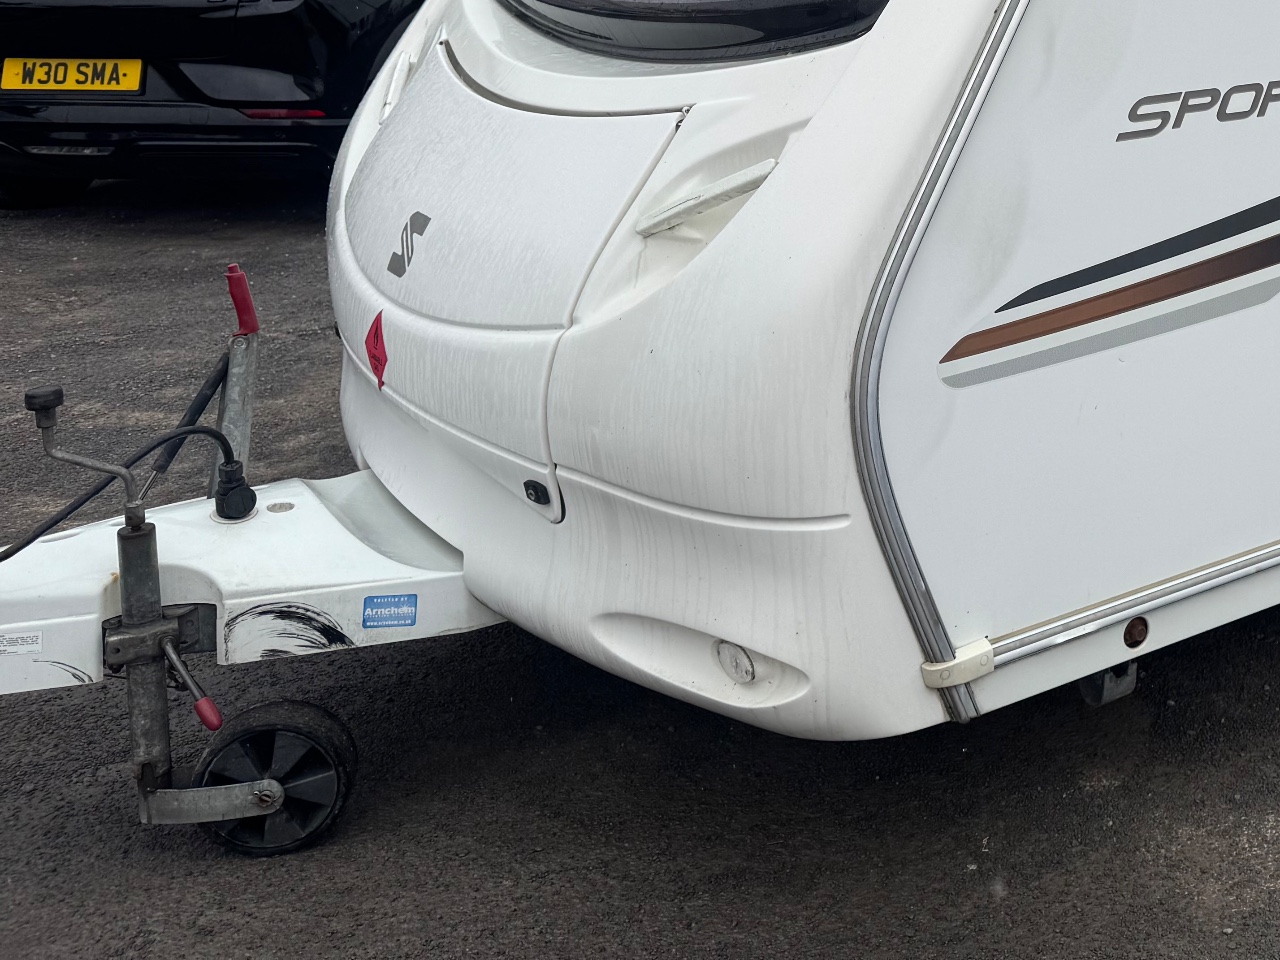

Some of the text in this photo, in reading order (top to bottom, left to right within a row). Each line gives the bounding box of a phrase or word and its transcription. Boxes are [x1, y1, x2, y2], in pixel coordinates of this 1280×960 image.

[21, 62, 120, 86] W30 SMA
[364, 606, 415, 615] Arnchem
